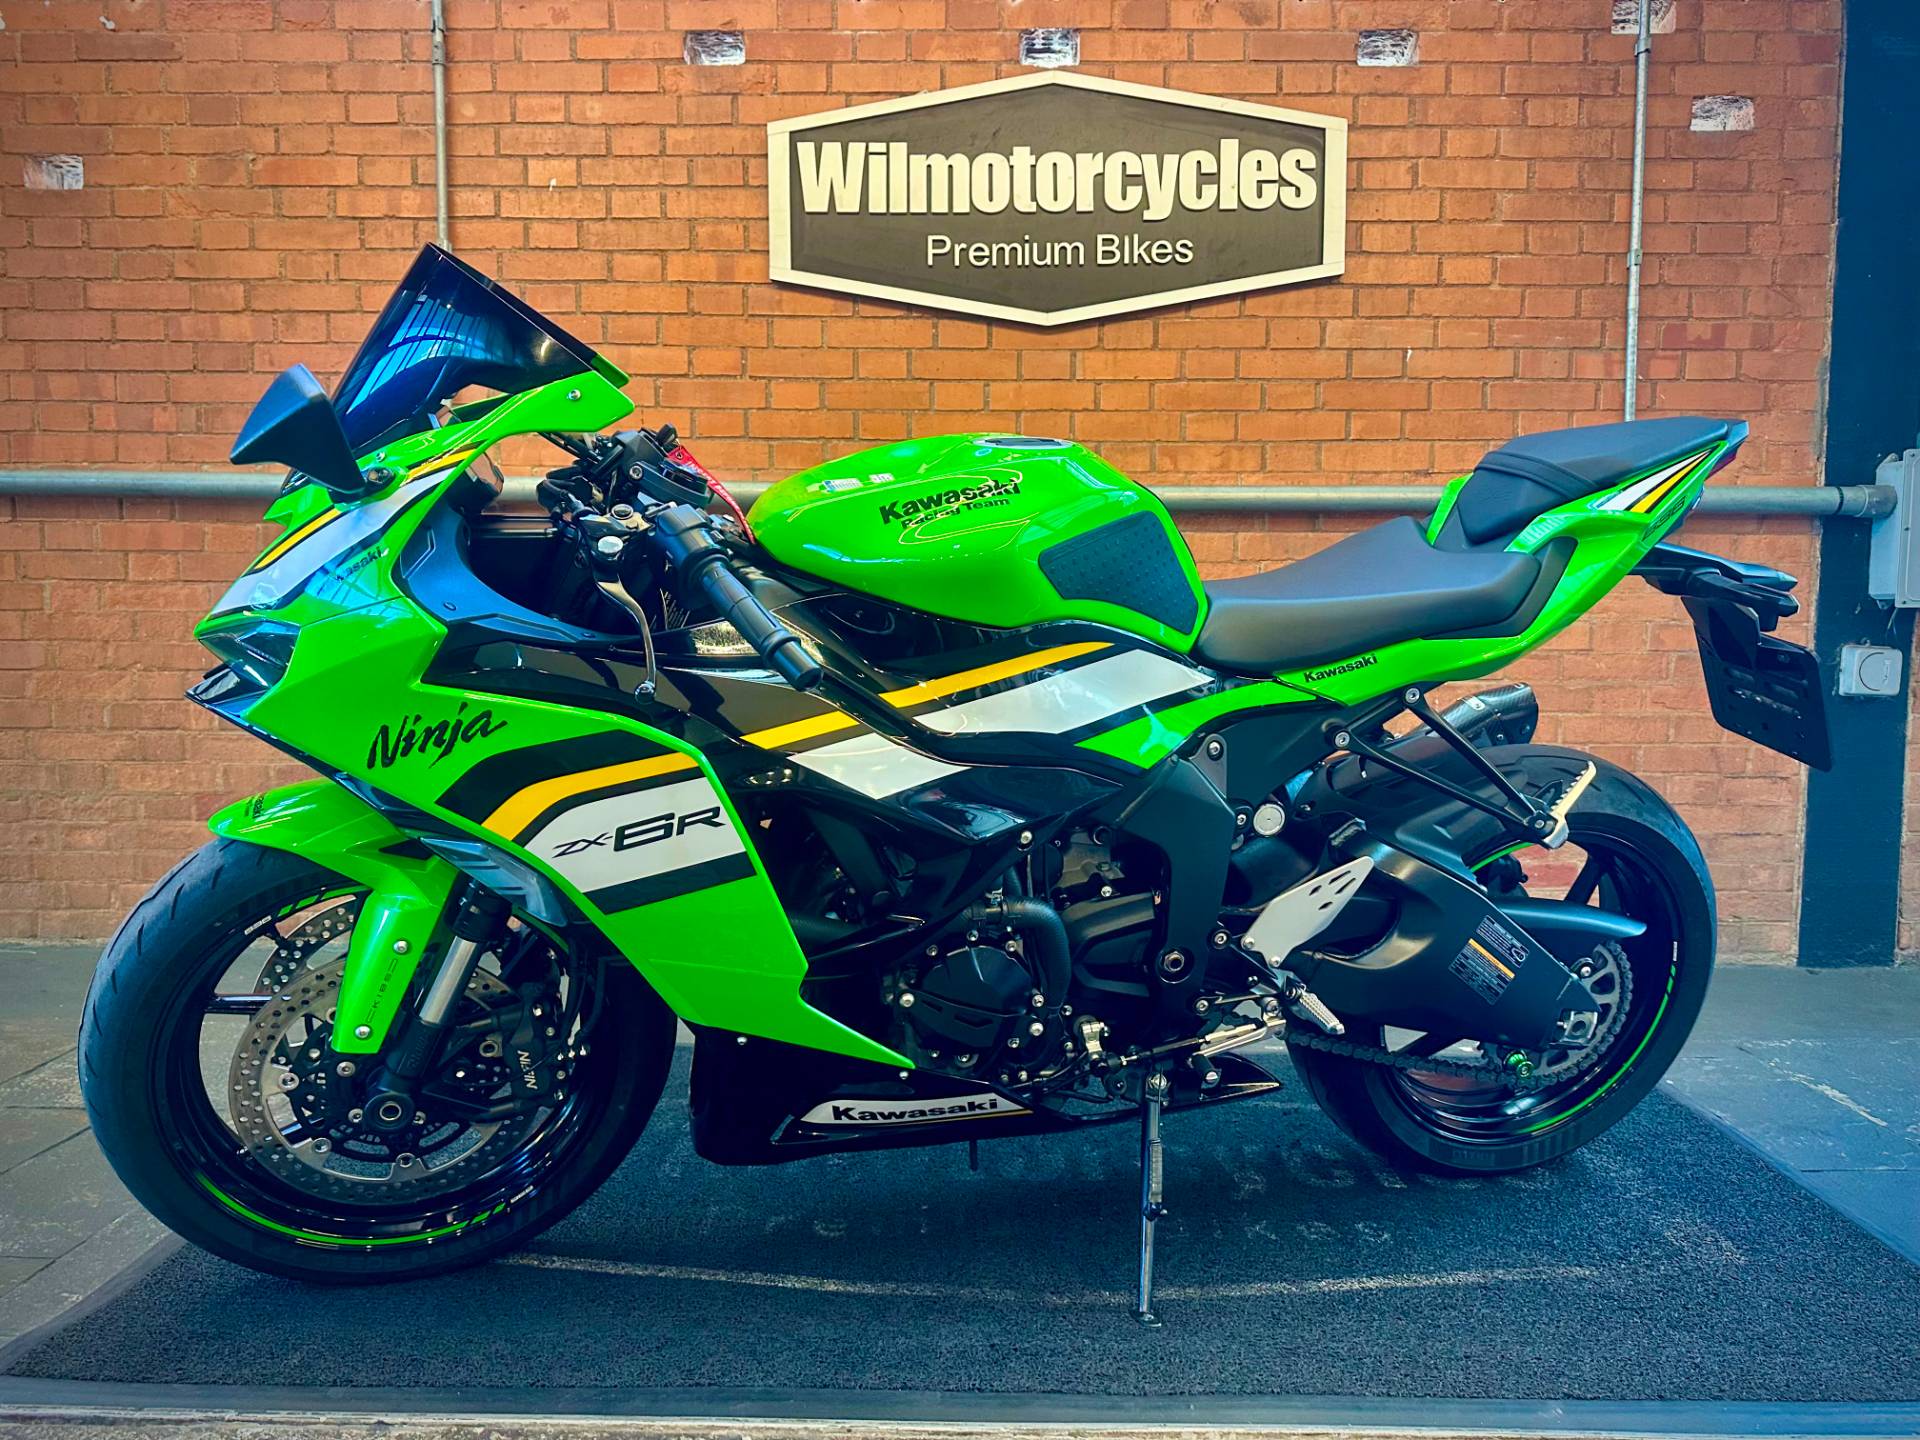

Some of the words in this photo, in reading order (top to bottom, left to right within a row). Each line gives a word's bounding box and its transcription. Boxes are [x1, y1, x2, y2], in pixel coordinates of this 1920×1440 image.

[796, 138, 1318, 221] Wilmotorcycles
[926, 234, 1085, 267] Premium
[879, 478, 1021, 525] Kawasaki
[959, 497, 1010, 512] Team
[1303, 653, 1379, 683] Kawasaki
[366, 701, 508, 770] Ninja
[552, 806, 726, 858] ZX-6R
[831, 1099, 998, 1122] Kawasaki
